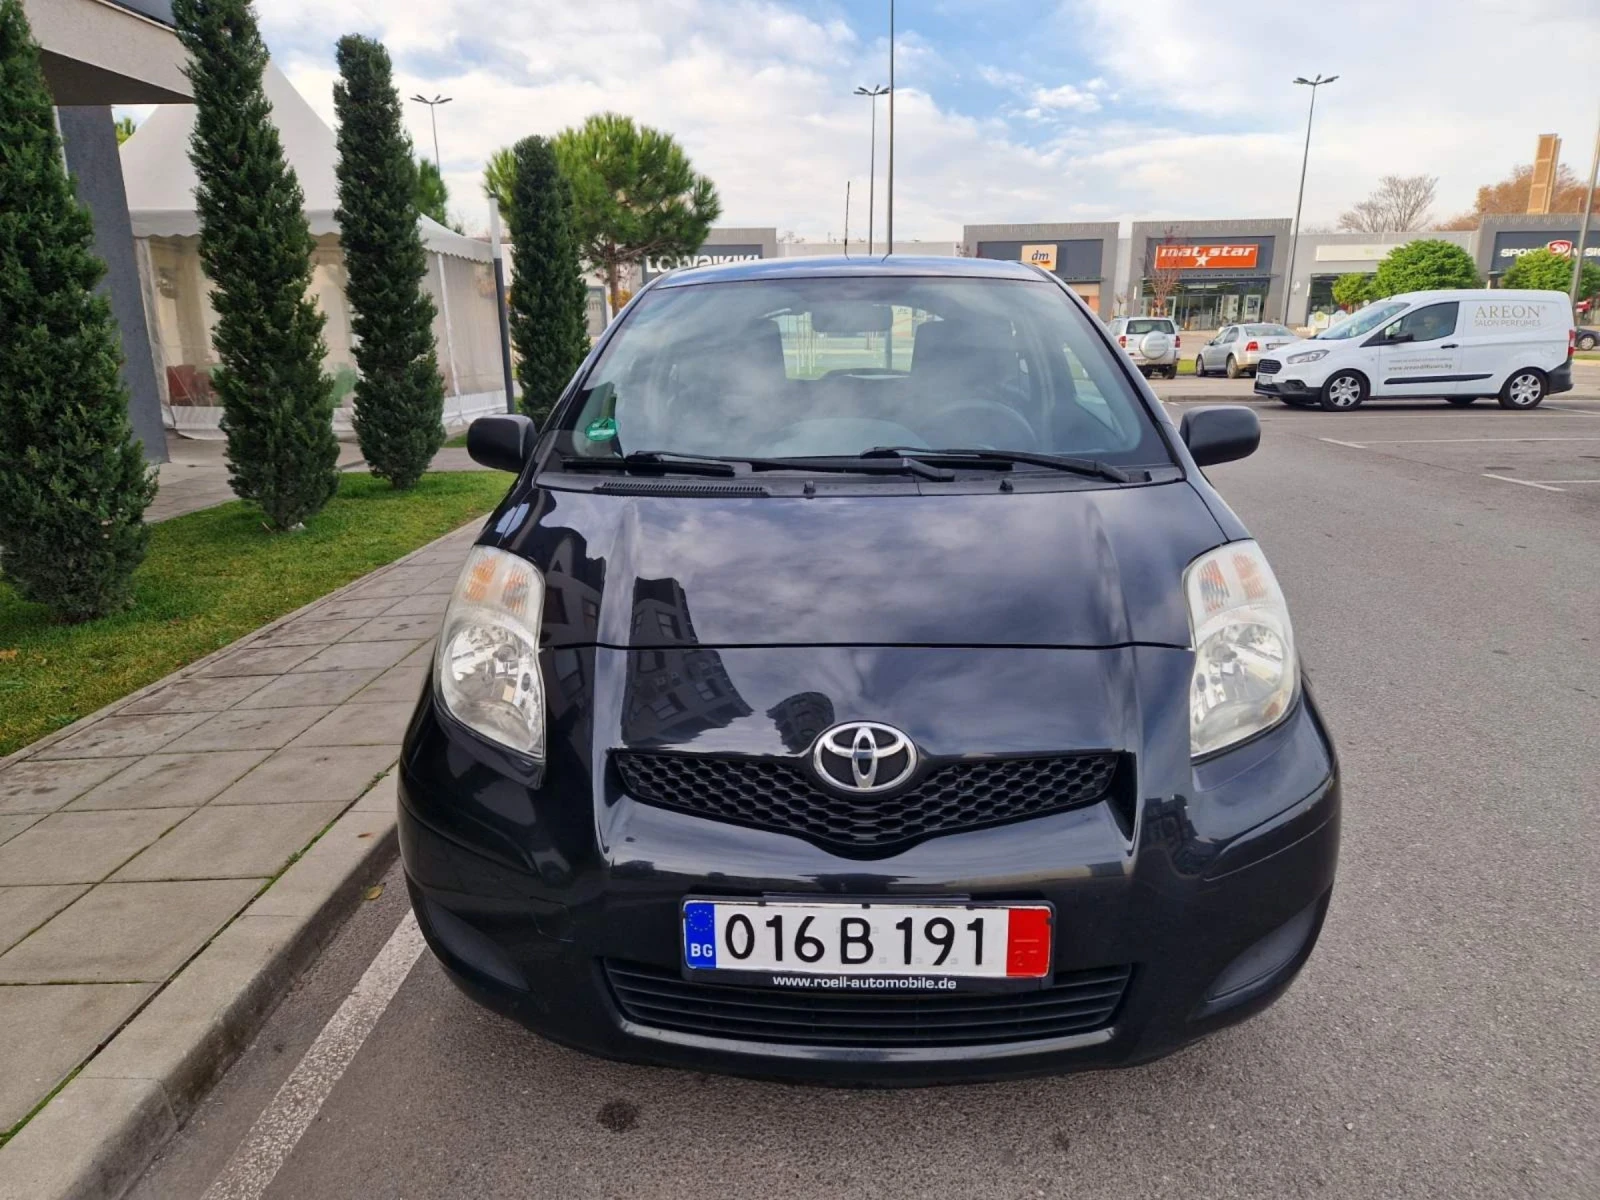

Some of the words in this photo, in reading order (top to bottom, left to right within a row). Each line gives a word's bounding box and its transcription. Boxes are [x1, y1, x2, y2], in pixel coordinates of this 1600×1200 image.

[1031, 250, 1049, 261] dm
[1160, 246, 1201, 257] mat
[1208, 246, 1255, 257] star
[1500, 247, 1538, 257] SPO
[645, 255, 672, 273] LC
[1475, 305, 1541, 319] AREON
[1474, 319, 1499, 327] SALON
[1500, 319, 1541, 327] PERFUMES
[725, 913, 826, 963] 016
[841, 917, 874, 965] B
[895, 916, 985, 966] 191
[690, 943, 714, 958] BG
[772, 974, 957, 991] www.roell-automobile.de
